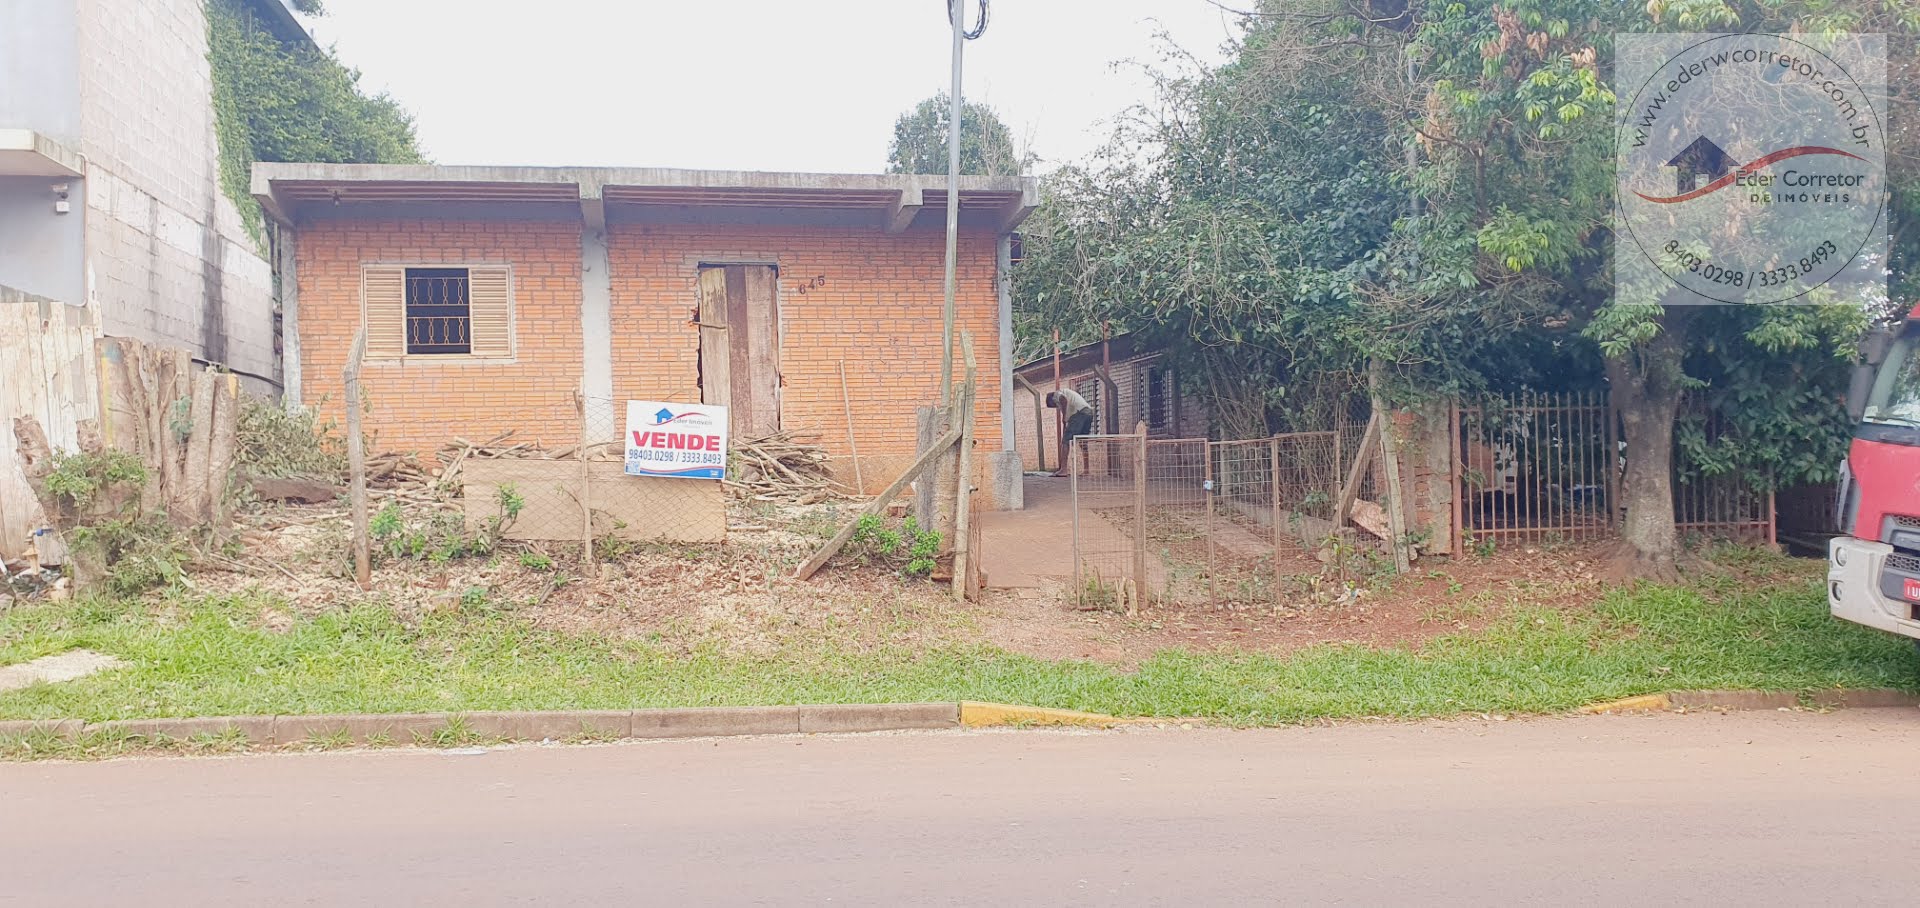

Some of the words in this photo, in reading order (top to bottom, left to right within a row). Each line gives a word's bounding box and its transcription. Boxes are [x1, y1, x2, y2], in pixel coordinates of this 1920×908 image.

[799, 275, 825, 294] 645
[632, 430, 720, 452] VENDE
[628, 449, 674, 462] 98403.0298
[681, 452, 722, 464] 3333.8493
[1906, 585, 1920, 597] IU
